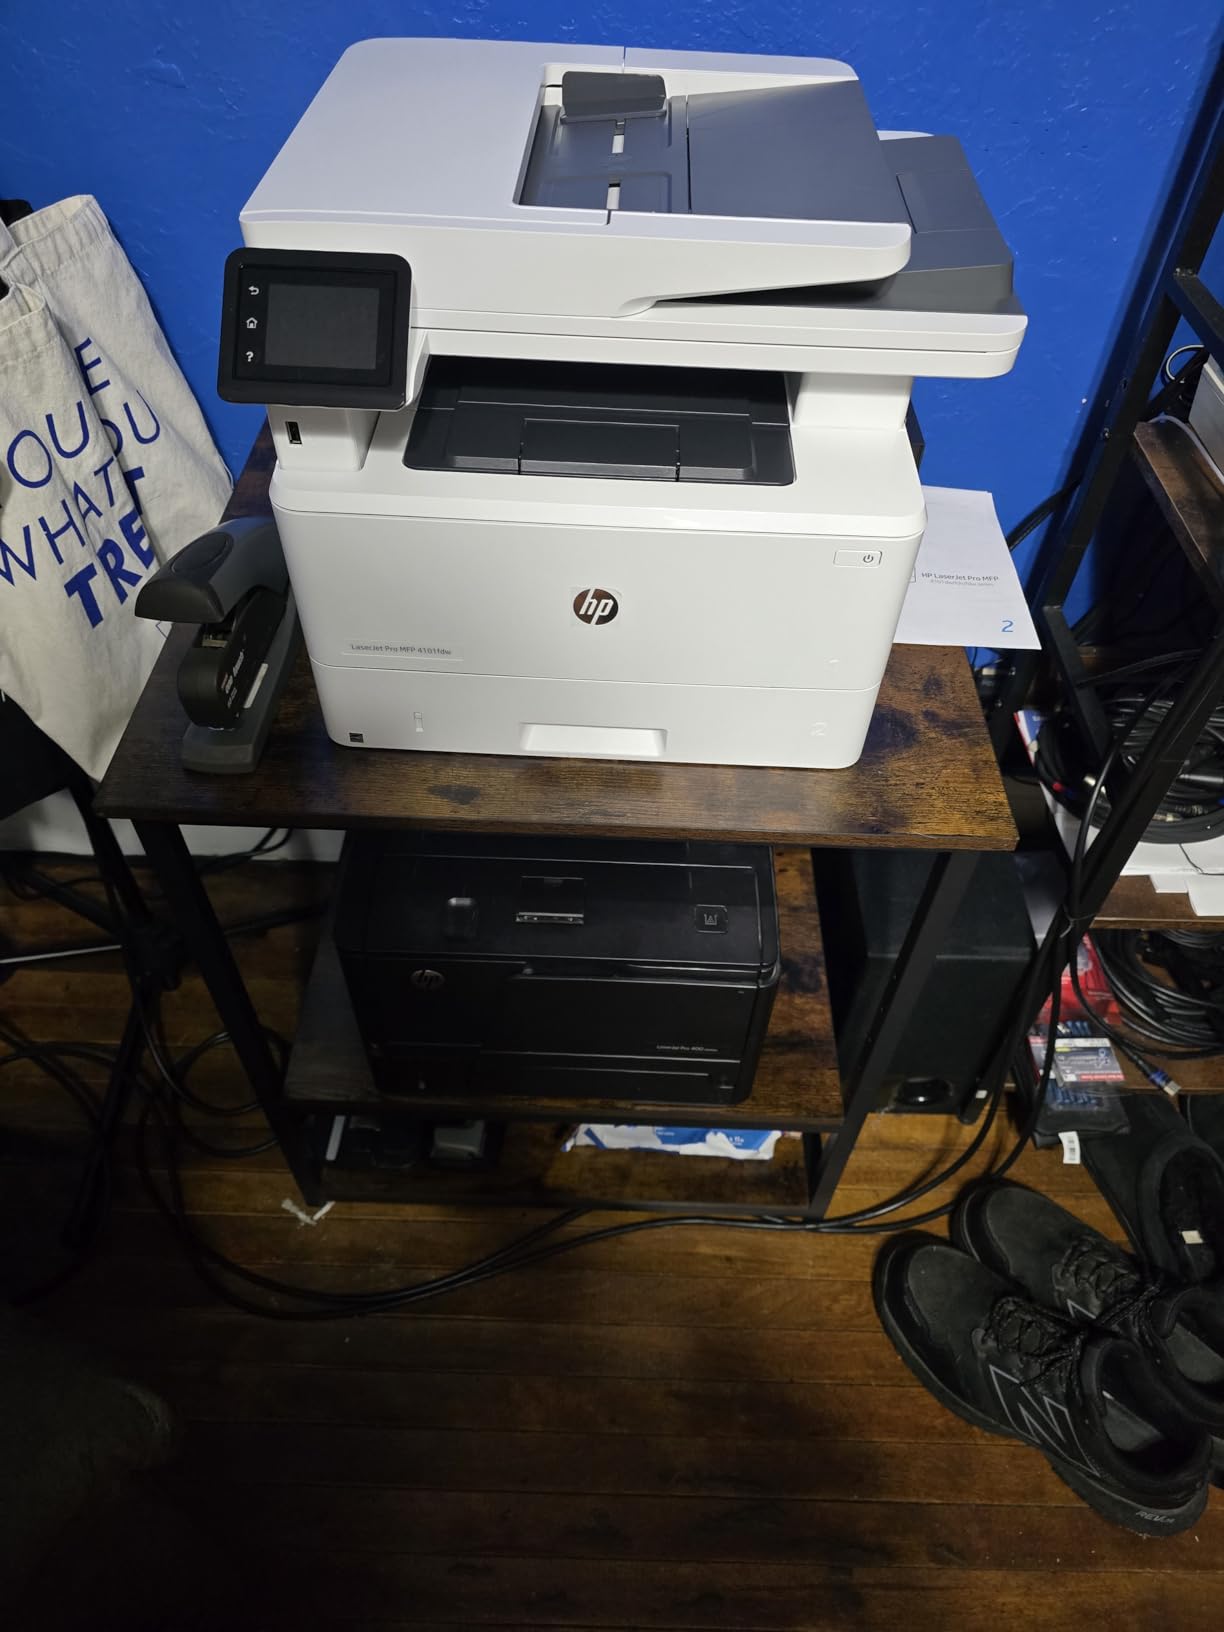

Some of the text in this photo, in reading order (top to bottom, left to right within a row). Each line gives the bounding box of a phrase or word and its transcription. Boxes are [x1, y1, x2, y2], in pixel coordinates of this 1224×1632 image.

[6, 400, 90, 489] OU
[0, 456, 117, 586] WHAT
[574, 588, 618, 626] hp
[1001, 619, 1014, 633] 2
